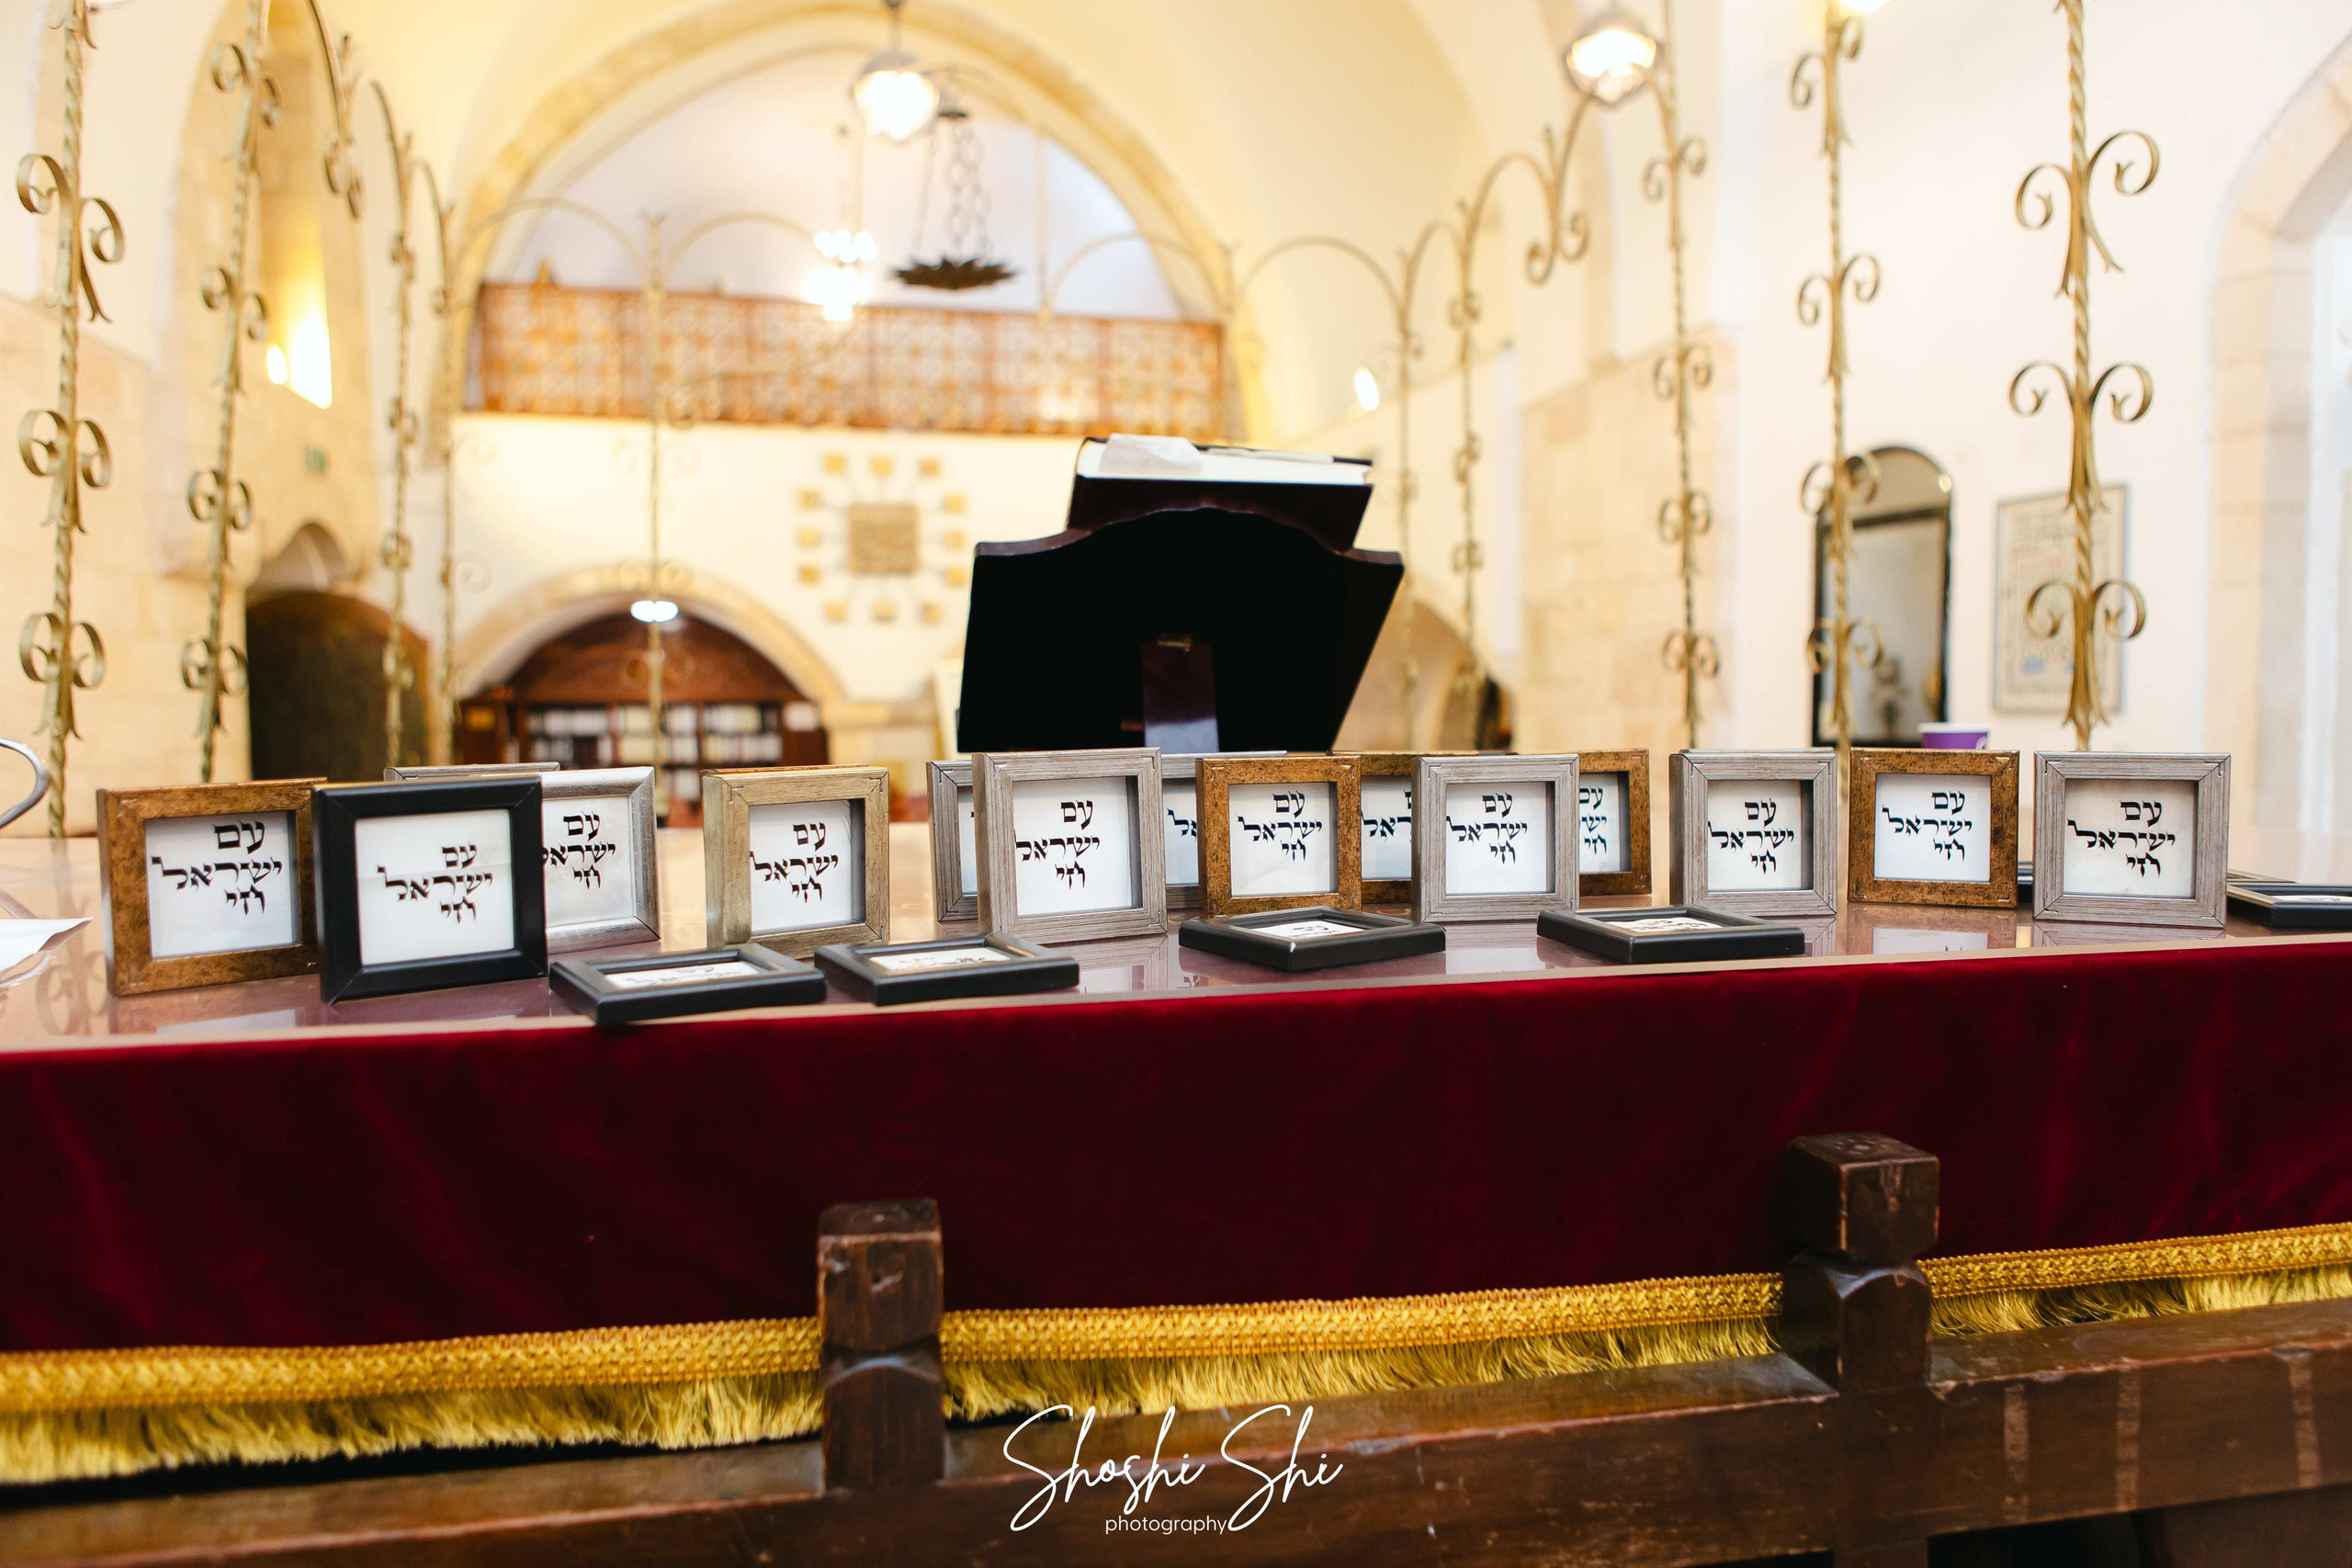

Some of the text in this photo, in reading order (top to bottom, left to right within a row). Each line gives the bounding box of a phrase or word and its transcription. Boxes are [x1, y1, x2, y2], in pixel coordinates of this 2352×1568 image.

[1060, 799, 1094, 831] עם
[1272, 788, 1306, 818] עם
[1481, 791, 1514, 818] עם
[1743, 797, 1778, 829] עם
[1931, 790, 1966, 816] עם
[2119, 799, 2164, 829] עם
[563, 810, 601, 842] עם
[1237, 815, 1323, 843] ישראל
[1446, 815, 1528, 843] ישראל
[1707, 817, 1794, 851] ישראל
[1882, 805, 1973, 837] ישראל
[2067, 818, 2177, 853] ישראל
[213, 819, 266, 854] עם
[792, 821, 827, 852] עם
[1281, 837, 1307, 862] חי
[1583, 833, 1608, 855] חי
[1933, 837, 1966, 863] חי
[441, 842, 477, 871] עם
[1488, 840, 1517, 864] חי
[1750, 848, 1778, 877] חי
[2125, 851, 2162, 879] חי
[151, 856, 282, 889] ישראל
[377, 864, 492, 900] ישראל
[573, 863, 602, 889] חי
[1055, 860, 1087, 890] חי
[224, 883, 266, 915] חי
[790, 874, 823, 903] חי
[439, 897, 476, 924] חי
